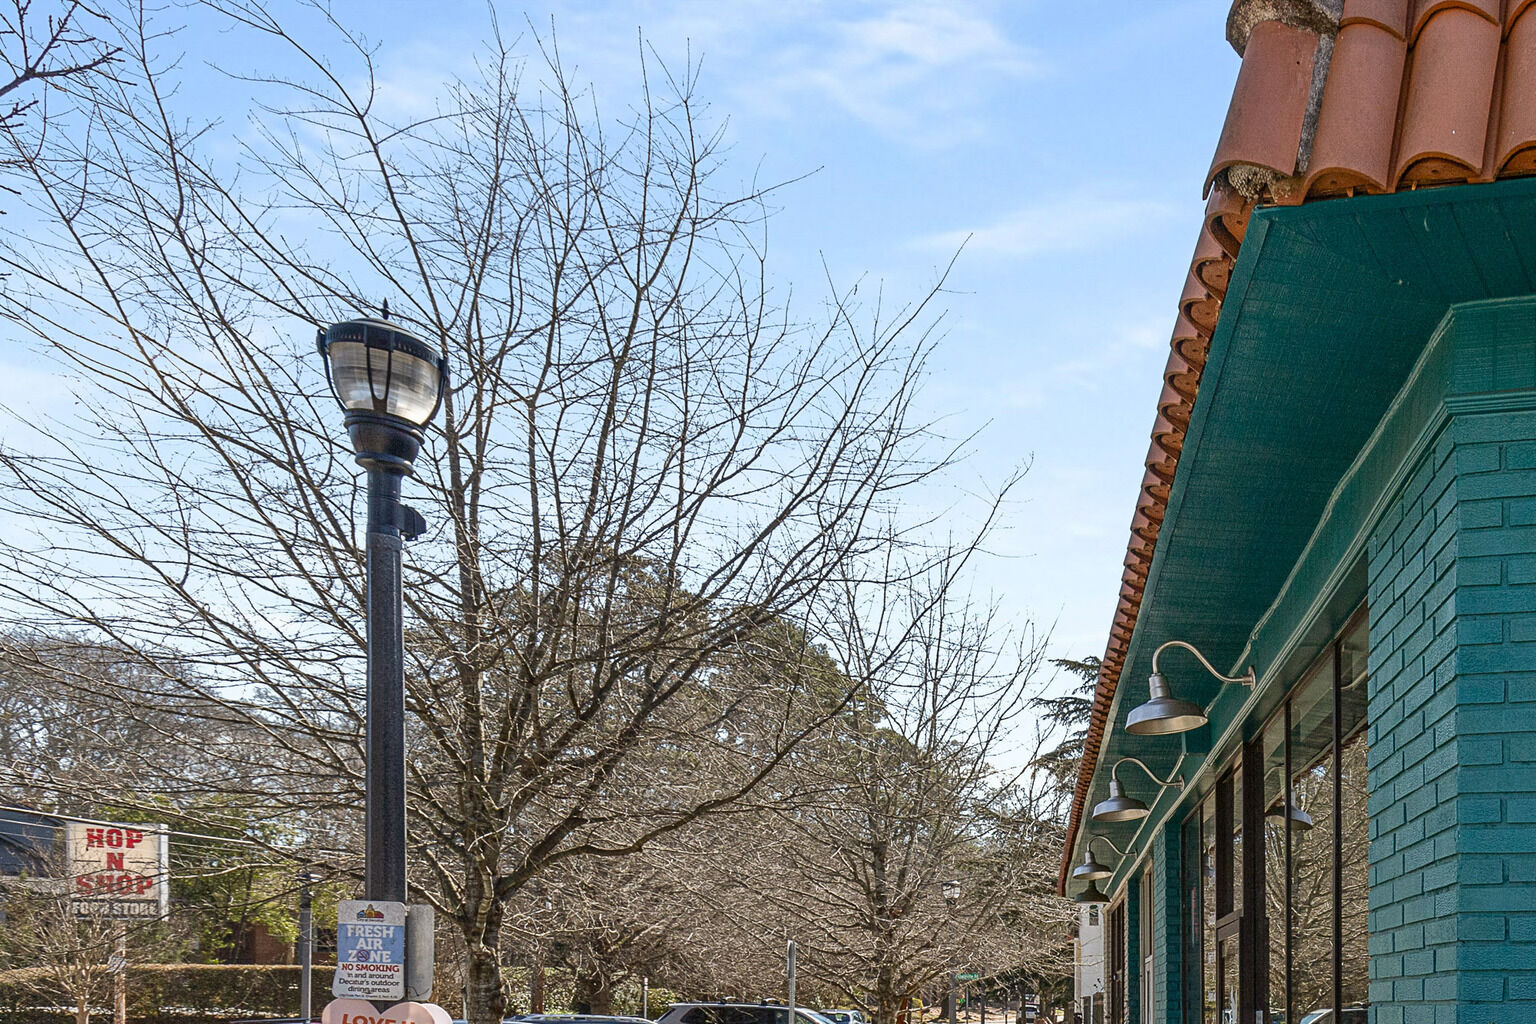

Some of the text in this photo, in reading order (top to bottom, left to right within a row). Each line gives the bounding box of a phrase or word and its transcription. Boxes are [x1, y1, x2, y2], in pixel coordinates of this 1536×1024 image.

[86, 828, 143, 849] HOP
[106, 852, 125, 871] N
[75, 874, 153, 895] SHOP
[112, 902, 157, 915] STORE
[347, 925, 394, 939] FRESH
[356, 938, 383, 950] AIR
[341, 963, 400, 973] NO SMOKING
[371, 979, 400, 987] outdoor
[348, 986, 370, 994] dining
